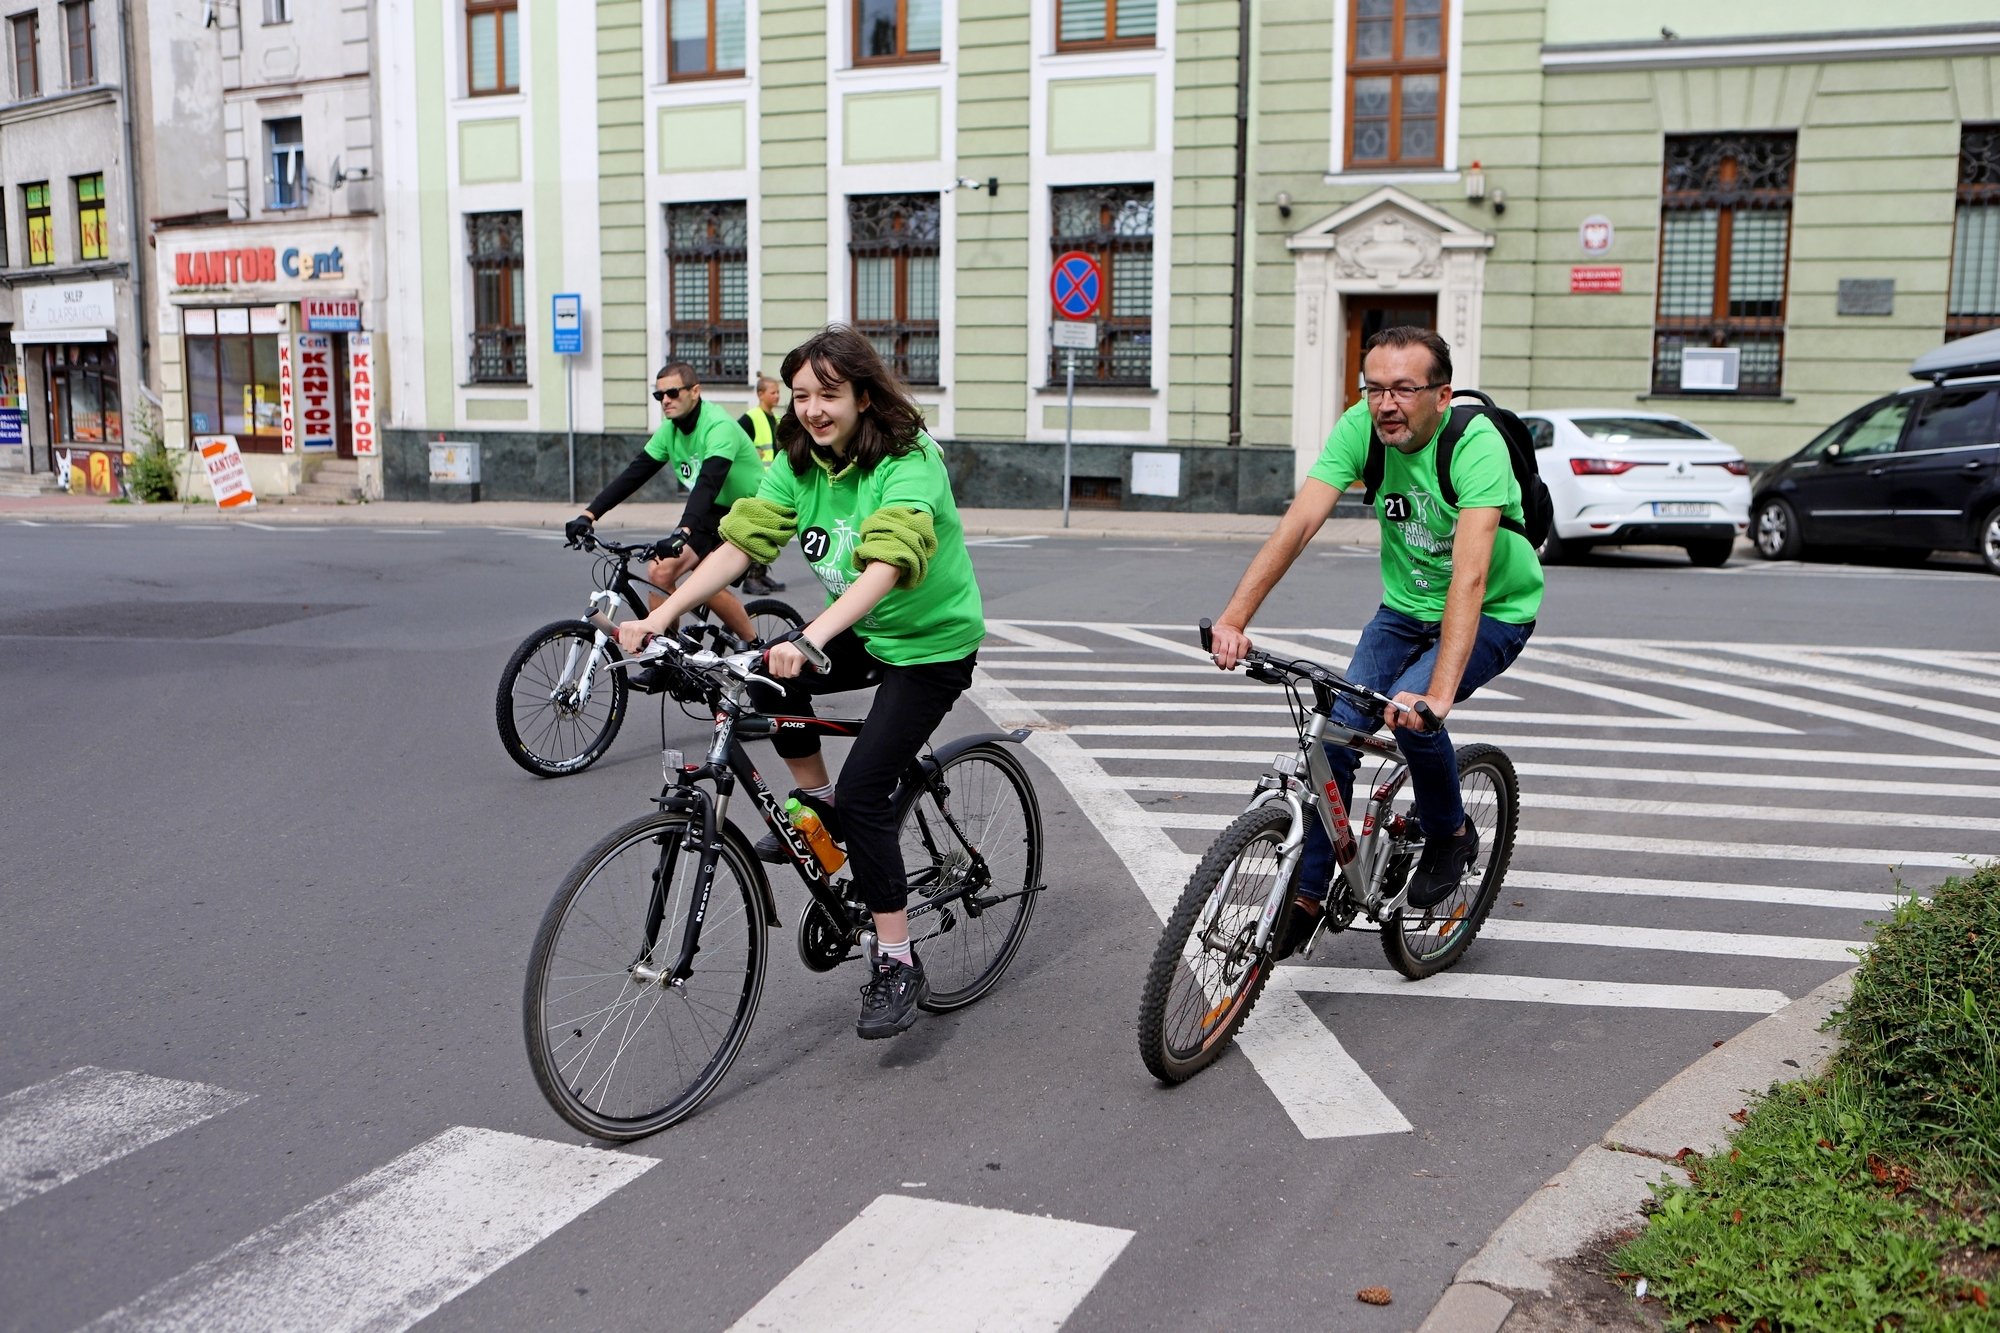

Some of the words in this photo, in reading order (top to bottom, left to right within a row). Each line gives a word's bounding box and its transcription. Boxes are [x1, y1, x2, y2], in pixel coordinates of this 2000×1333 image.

[175, 247, 276, 286] KANTOR
[282, 246, 344, 281] Cent
[64, 289, 83, 303] SKLEP
[310, 302, 358, 316] KANTOR
[300, 336, 328, 347] Cent
[281, 347, 293, 449] KANTOR
[302, 352, 330, 435] KANTOR
[353, 353, 373, 452] KANTOR
[208, 452, 241, 474] KANTOR
[681, 464, 691, 476] 21
[1385, 498, 1405, 517] 21
[804, 530, 826, 557] 21
[696, 882, 711, 922] Neon
